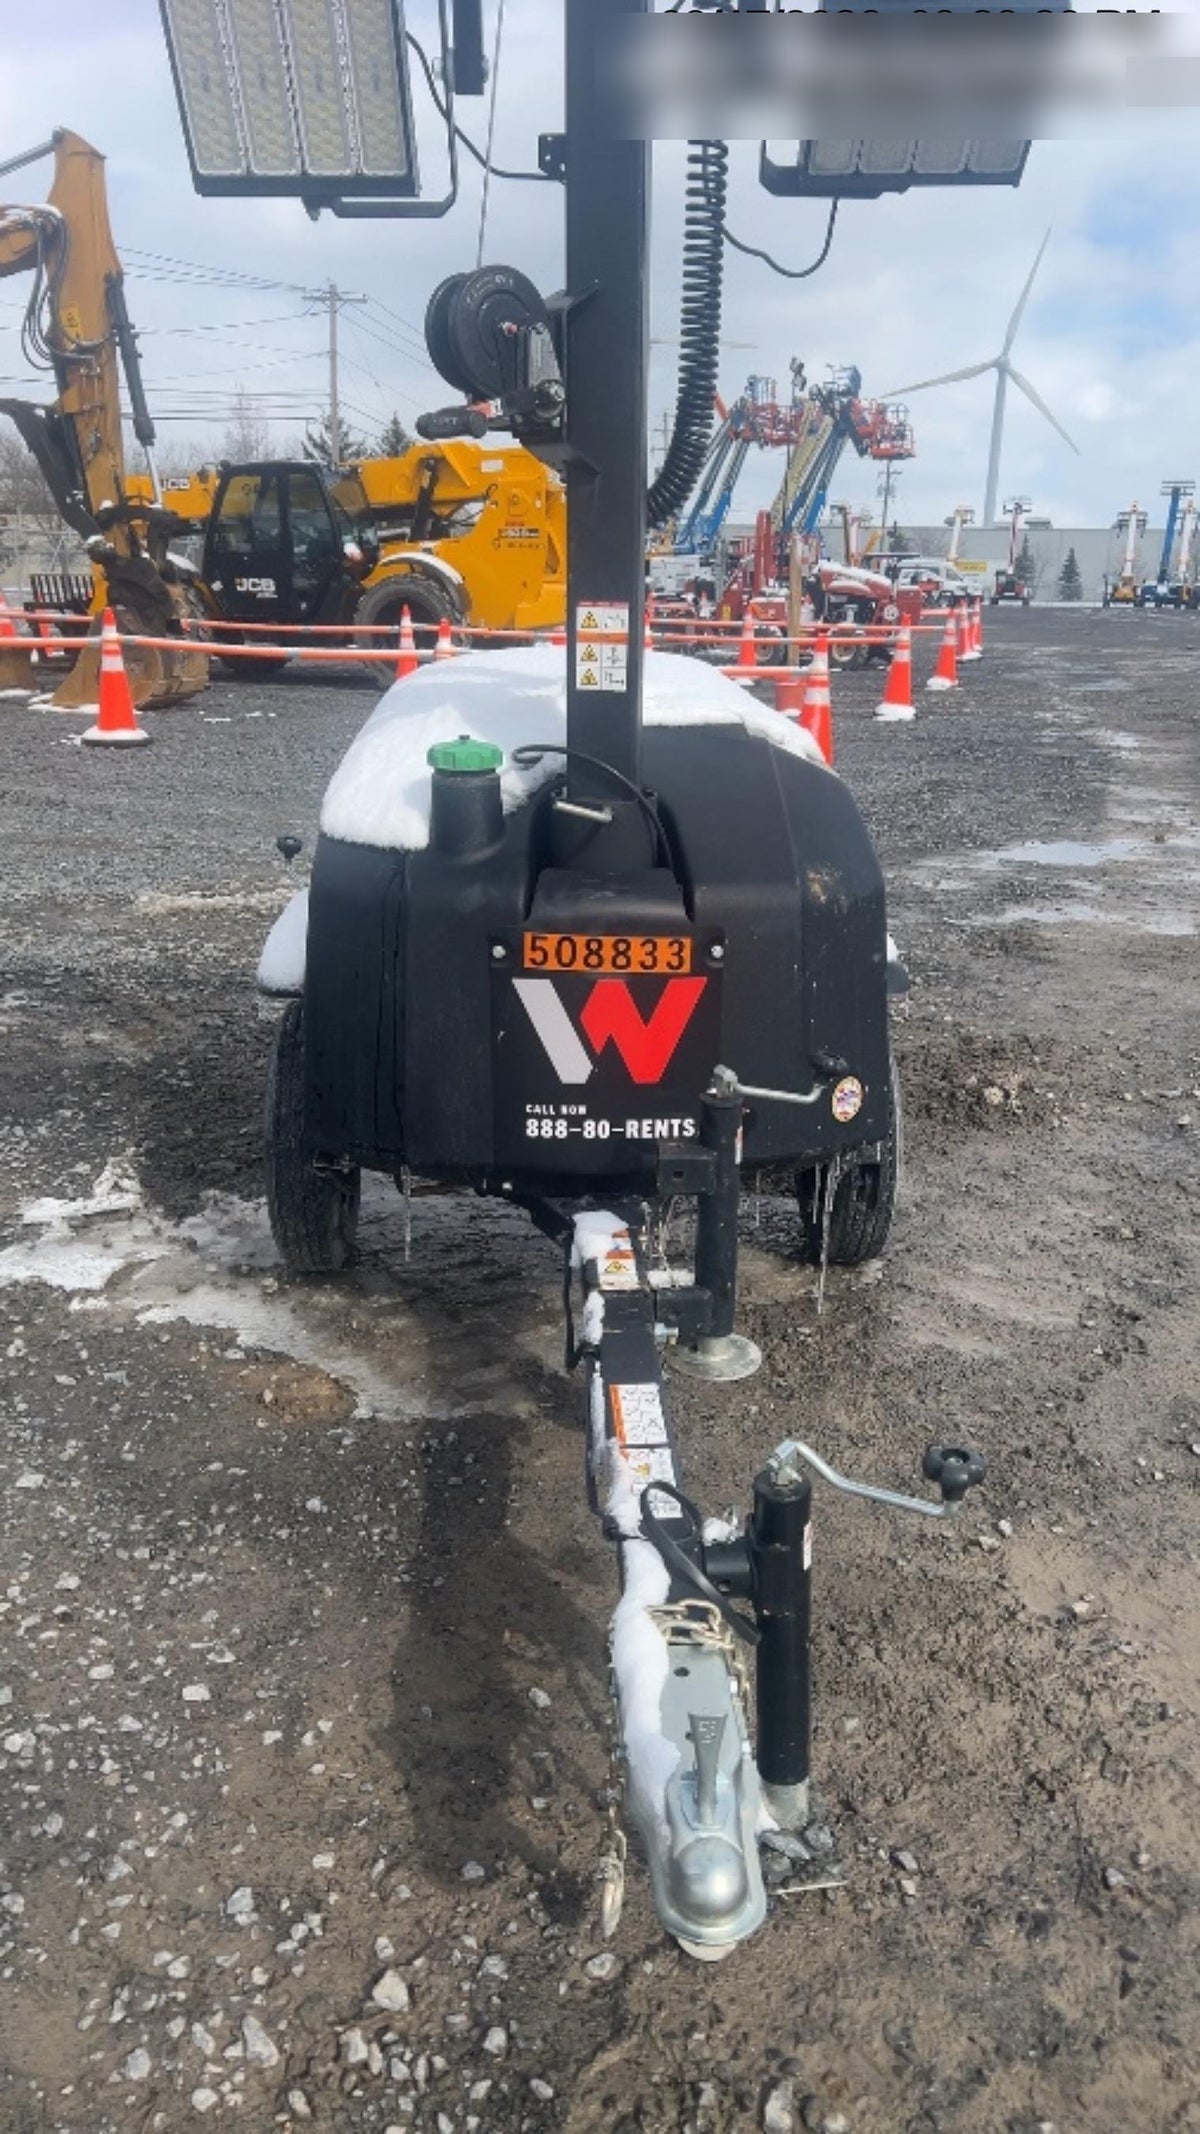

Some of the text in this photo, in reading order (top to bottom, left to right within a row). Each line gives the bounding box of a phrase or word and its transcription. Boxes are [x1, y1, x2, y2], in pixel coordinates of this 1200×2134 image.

[234, 578, 276, 592] JCB
[529, 936, 685, 970] 508833
[525, 1103, 587, 1116] CALL NOW
[526, 1118, 696, 1139] 888-80-RENTS
